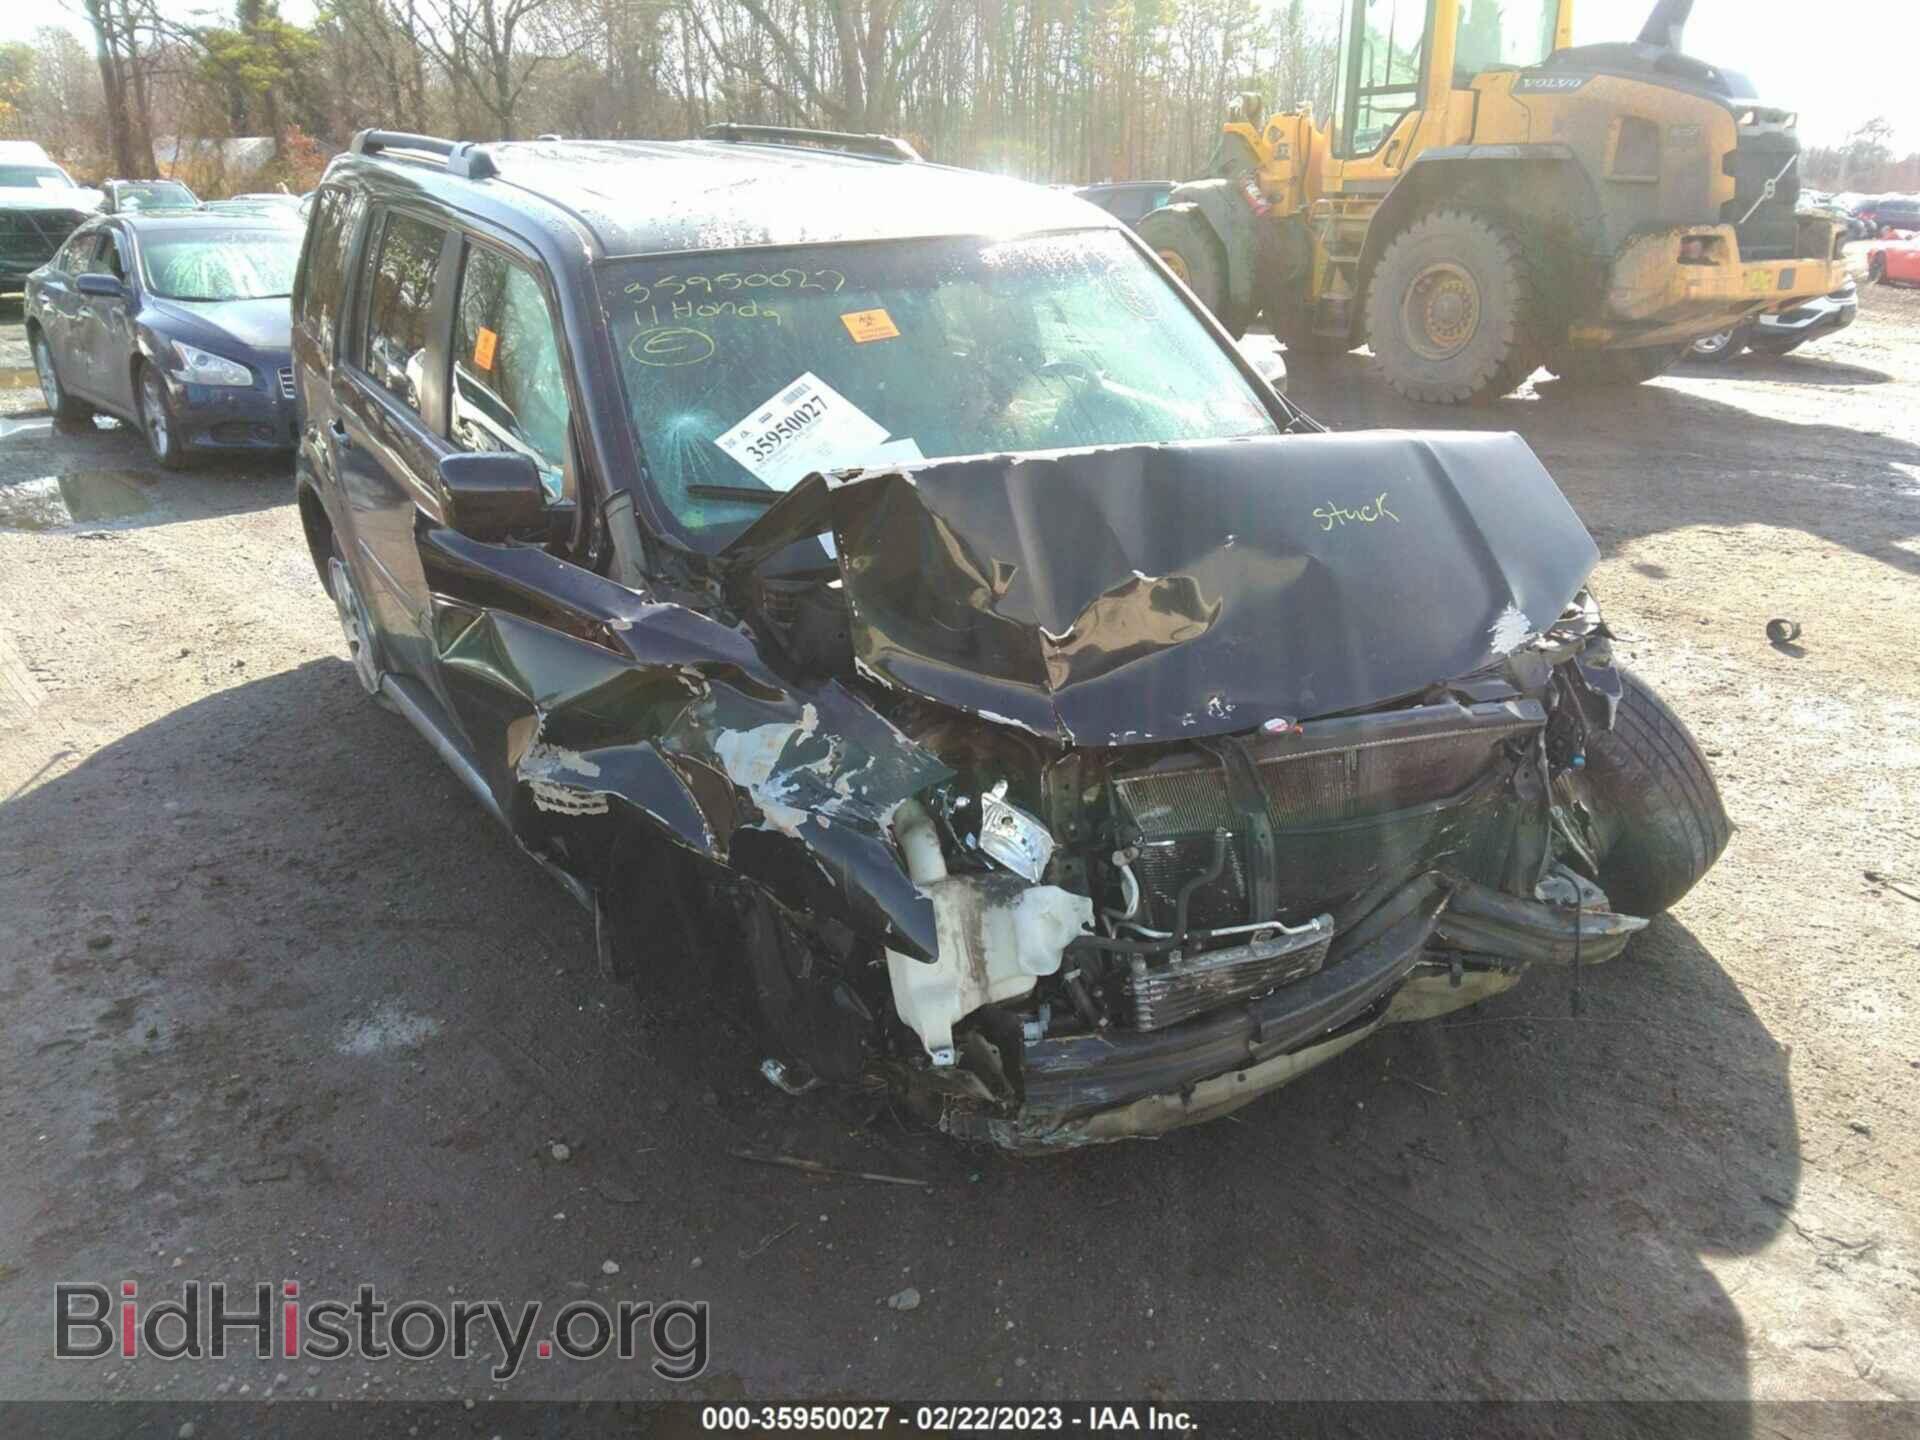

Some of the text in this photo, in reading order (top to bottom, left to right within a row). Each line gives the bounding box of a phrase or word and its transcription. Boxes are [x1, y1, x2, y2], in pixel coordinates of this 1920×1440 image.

[1523, 78, 1582, 88] VOLVO
[624, 269, 845, 303] 35950027
[672, 300, 781, 327] Honda
[746, 395, 828, 462] 35950027
